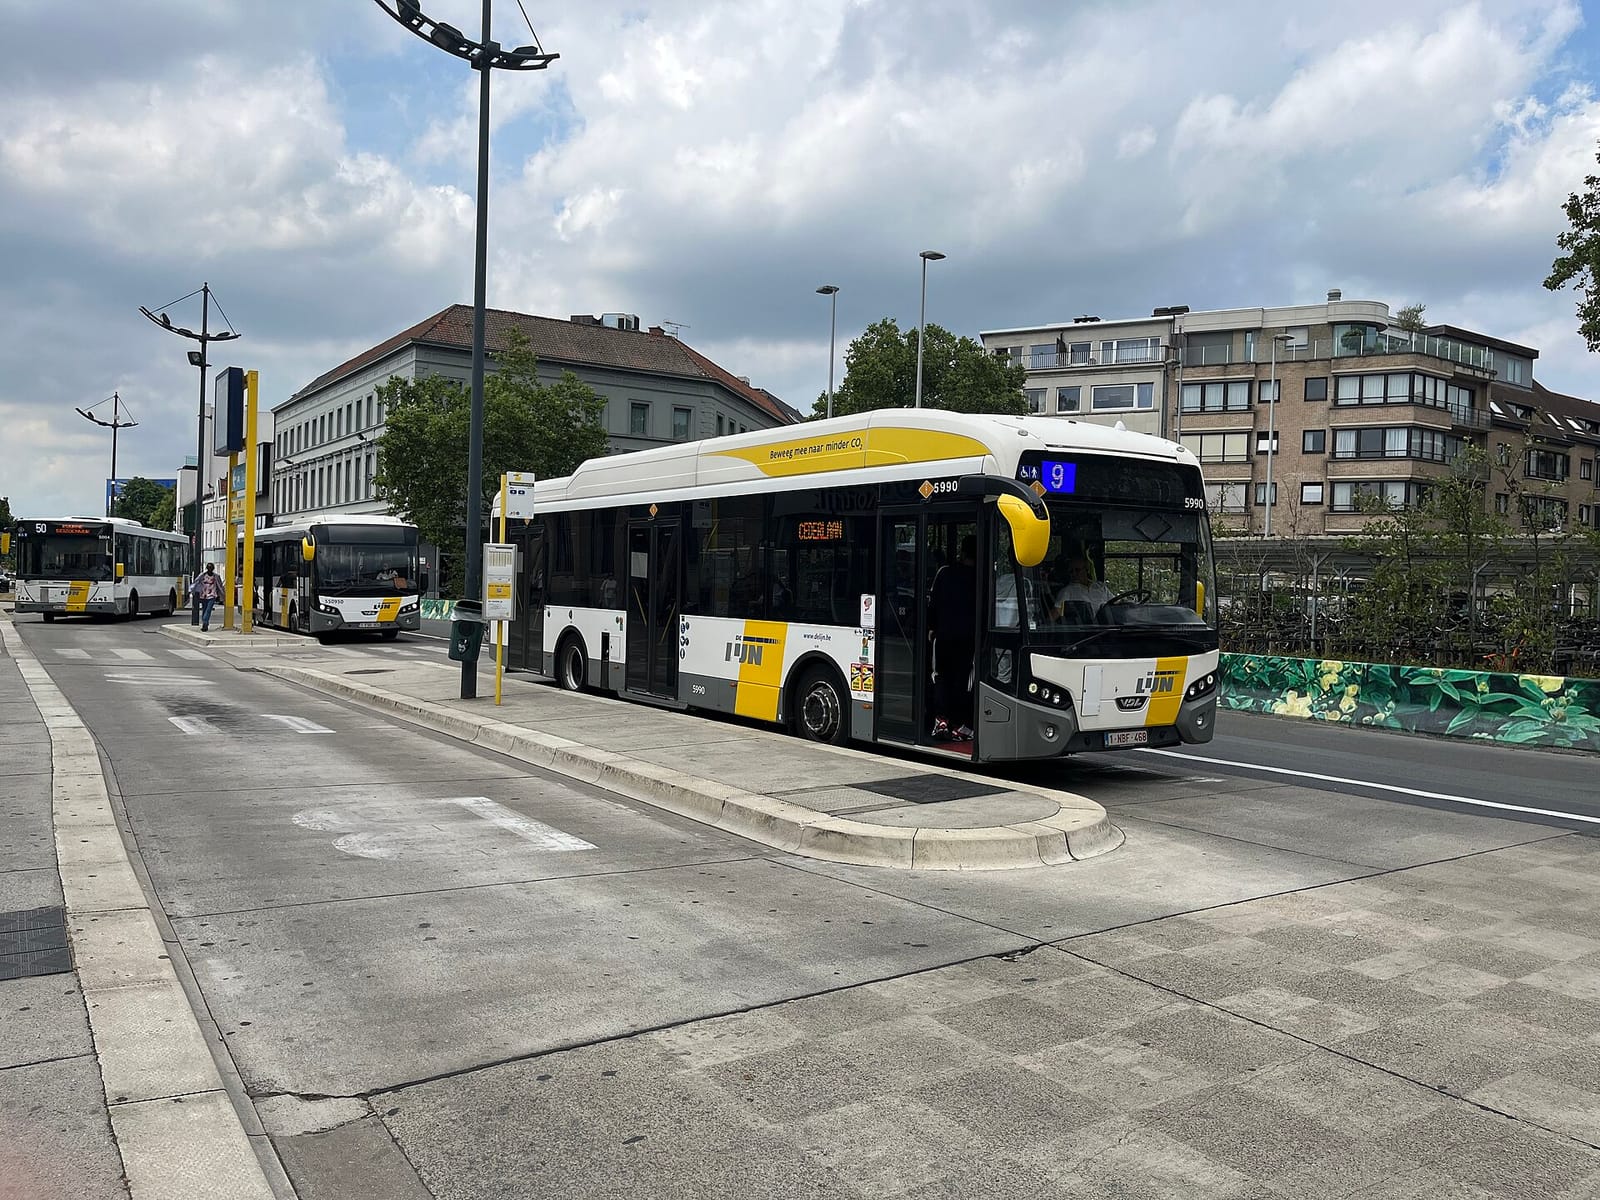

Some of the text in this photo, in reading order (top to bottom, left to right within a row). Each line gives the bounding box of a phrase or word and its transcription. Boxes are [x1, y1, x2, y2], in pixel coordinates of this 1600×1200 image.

[769, 449, 793, 460] Beweeg
[794, 446, 807, 456] mee
[808, 444, 824, 454] naar
[825, 440, 850, 452] minder
[1050, 463, 1065, 489] 9
[933, 480, 958, 494] 5990
[1184, 497, 1204, 510] 5990
[35, 523, 47, 533] 50
[803, 632, 832, 642] www.delijn.be
[692, 684, 706, 695] 5990
[1135, 676, 1174, 694] LIJN
